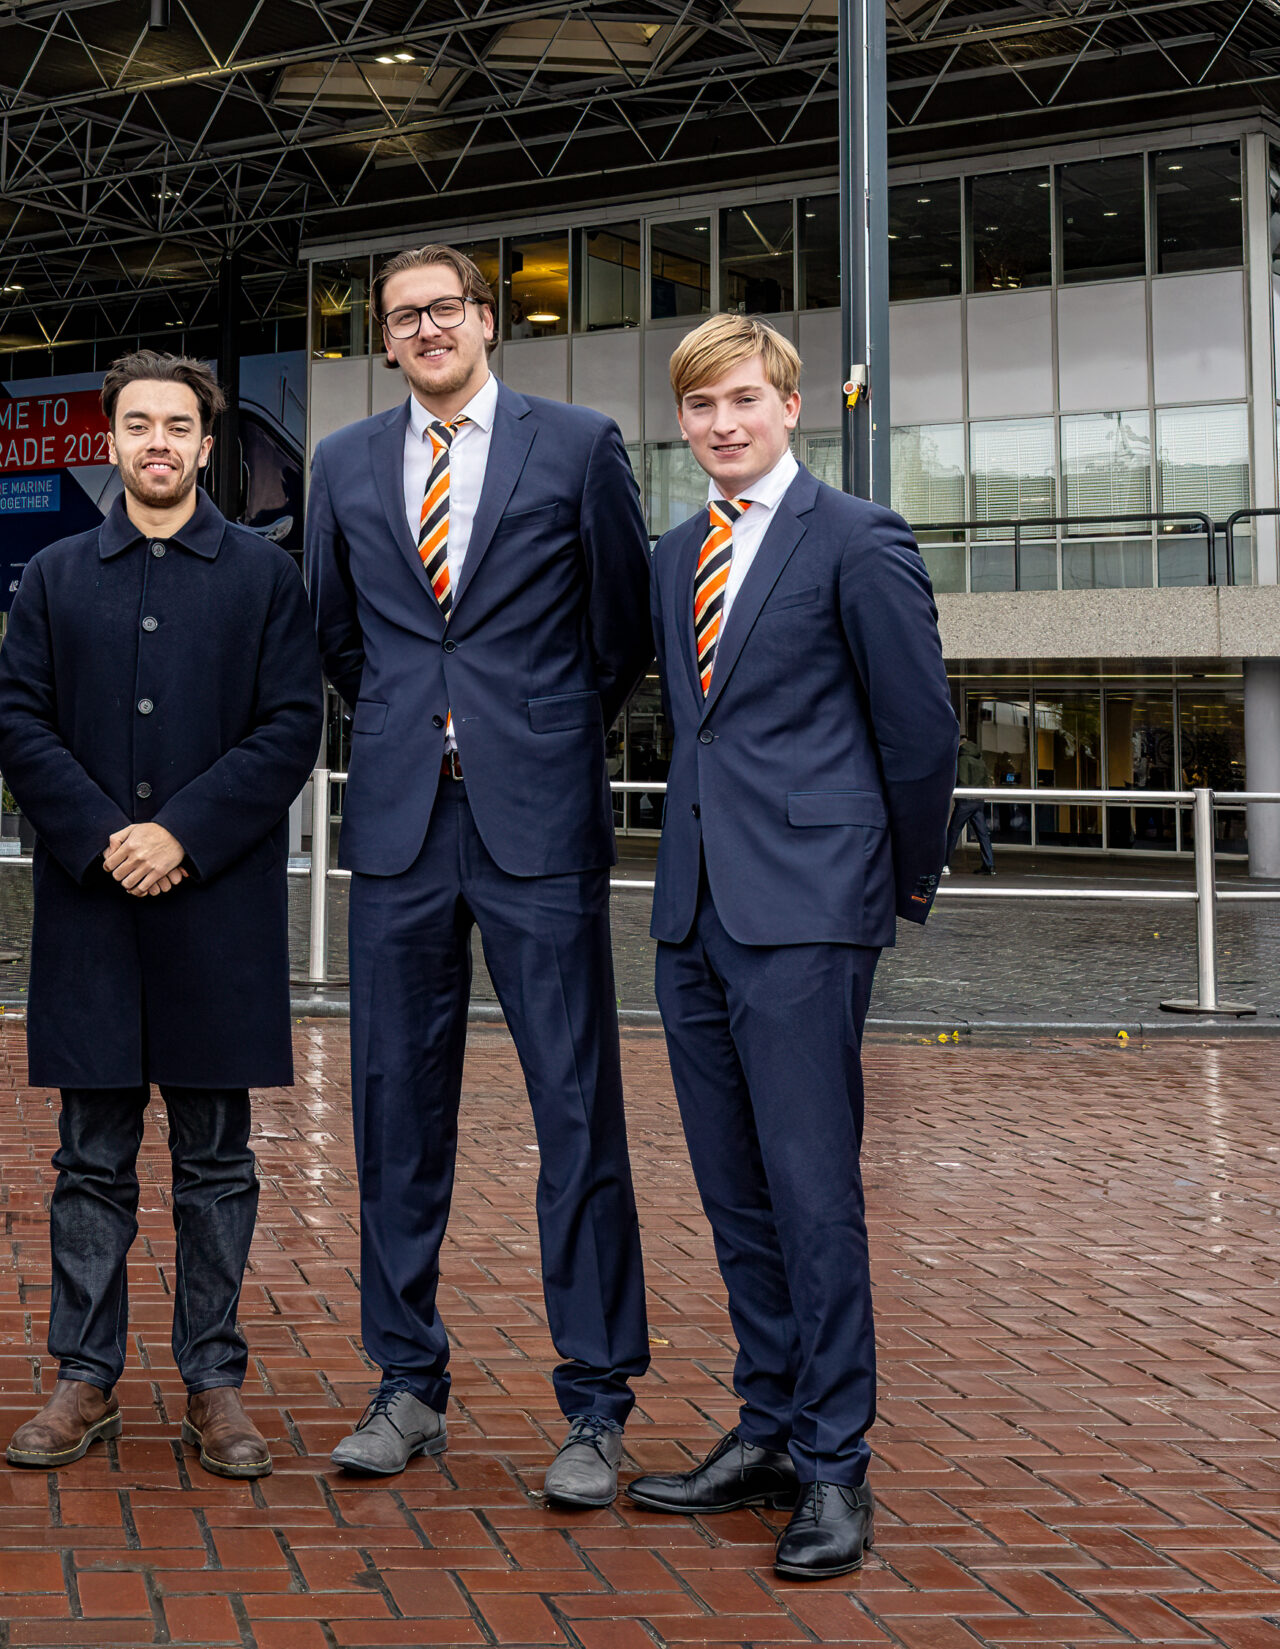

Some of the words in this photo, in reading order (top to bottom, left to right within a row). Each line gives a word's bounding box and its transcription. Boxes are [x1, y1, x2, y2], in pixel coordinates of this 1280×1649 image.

[38, 398, 68, 427] TO
[63, 431, 107, 463] 202
[11, 479, 53, 495] MARINE
